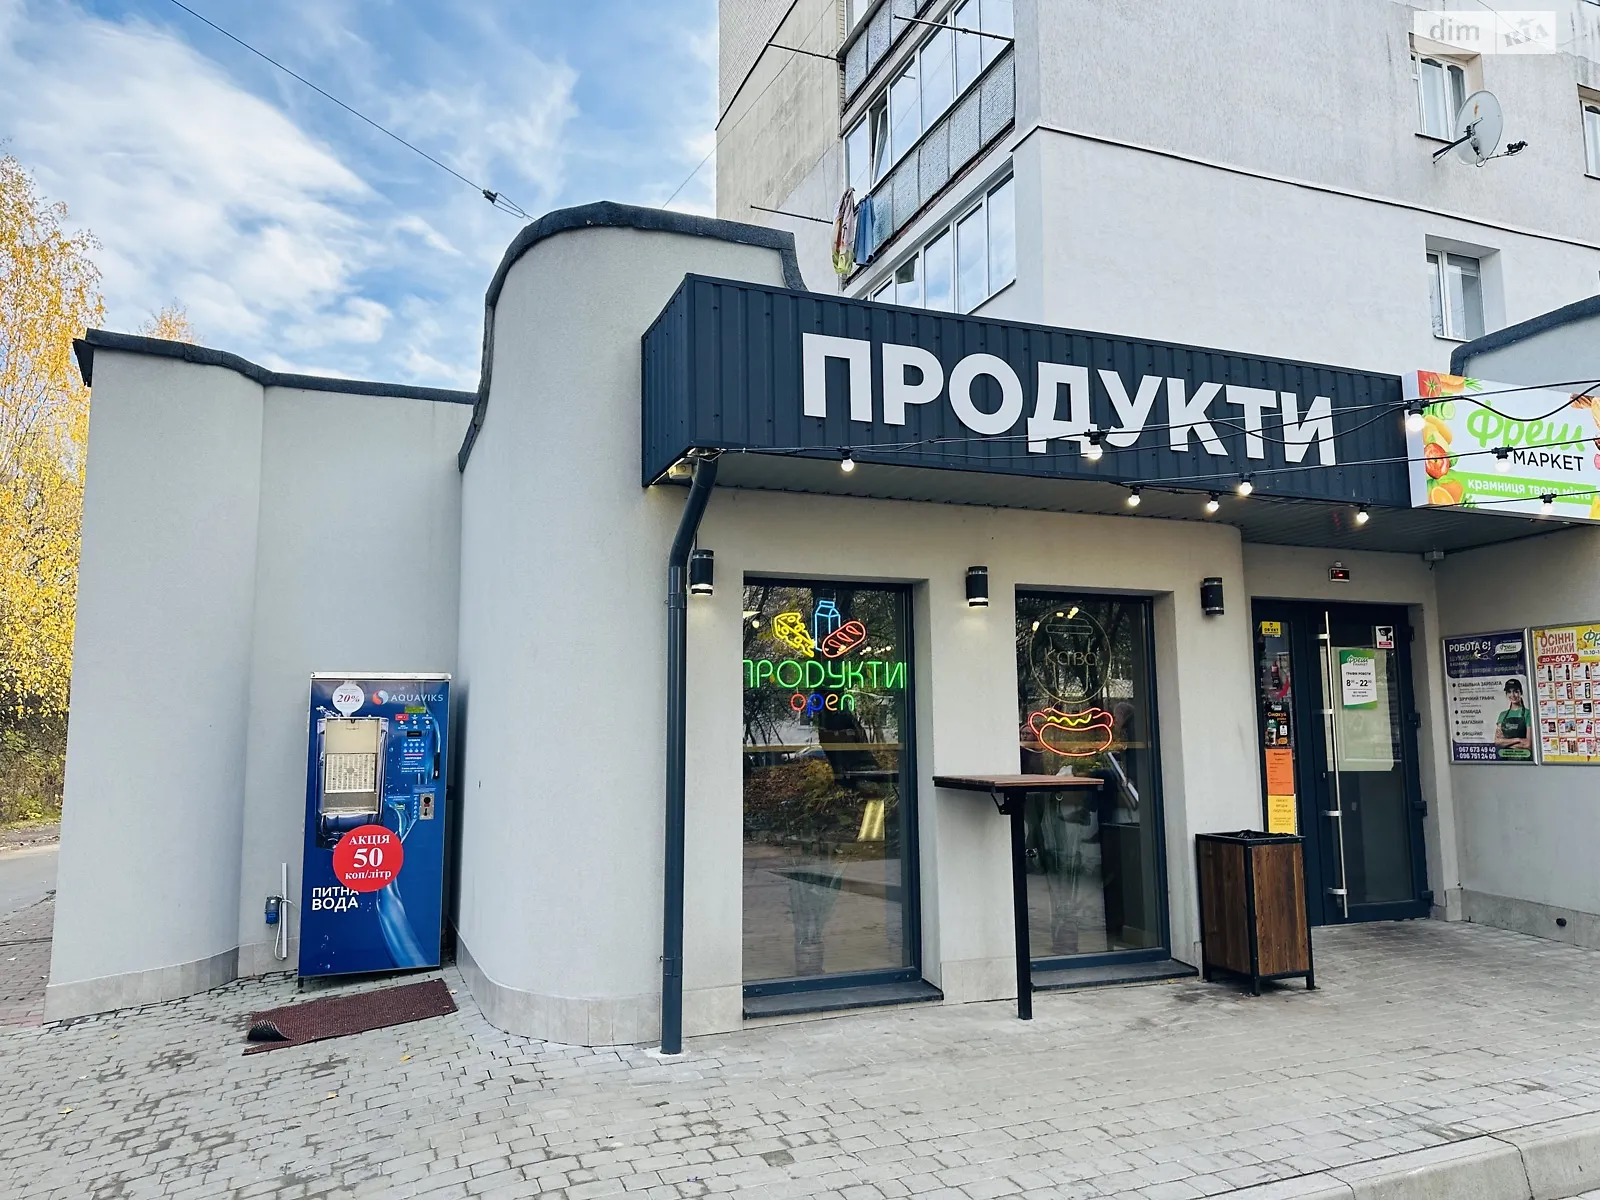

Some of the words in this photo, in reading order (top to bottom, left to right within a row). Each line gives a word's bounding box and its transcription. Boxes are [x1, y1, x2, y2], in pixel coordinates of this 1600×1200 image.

[802, 332, 1336, 467] ПРОДУКТИ
[1466, 399, 1586, 452] Фреш
[1513, 450, 1584, 472] МАРКЕТ
[1467, 478, 1526, 495] крамниця
[1449, 642, 1481, 653] РОБОТА
[1540, 632, 1574, 648] ОСІННІ
[1541, 642, 1575, 655] ЗНИЖКИ
[391, 694, 444, 702] AQUAVIKS
[790, 693, 856, 718] open
[348, 834, 391, 846] АКЦІЯ
[352, 847, 384, 868] 50
[344, 869, 392, 881] коп/літр
[311, 897, 359, 913] ВОДА
